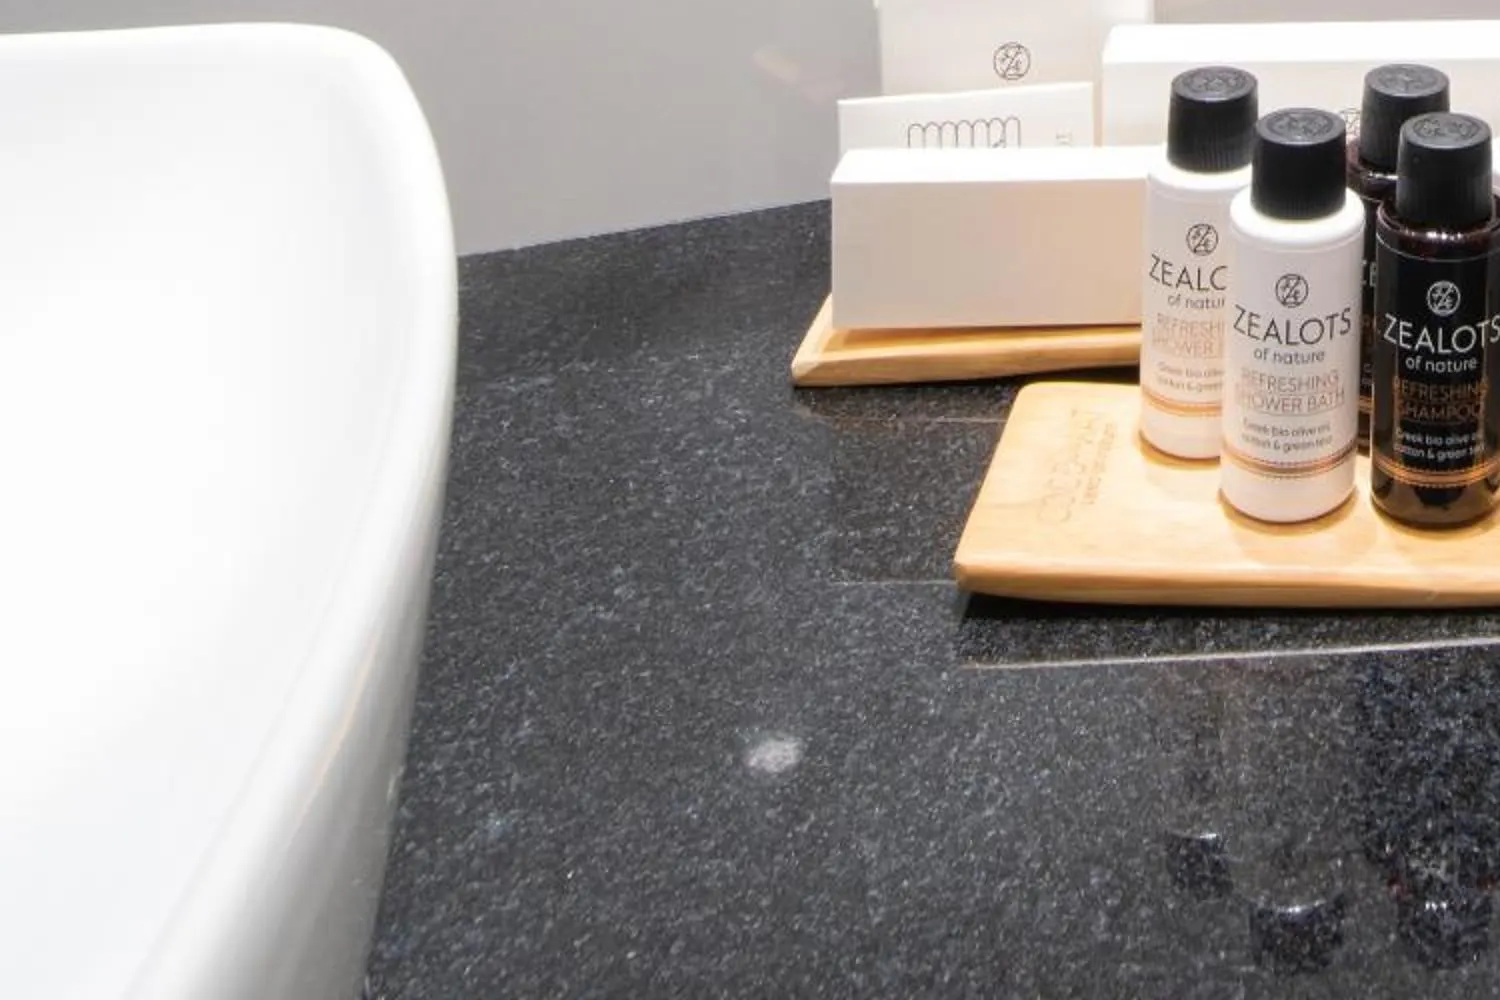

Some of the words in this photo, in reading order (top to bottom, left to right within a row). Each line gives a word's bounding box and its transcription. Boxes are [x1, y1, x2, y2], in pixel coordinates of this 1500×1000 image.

[1149, 253, 1228, 292] ZEALO
[1168, 293, 1182, 306] of
[1233, 304, 1352, 347] ZEALOTS
[1383, 313, 1500, 354] ZEALOTS
[1254, 348, 1269, 361] of
[1274, 349, 1326, 365] nature
[1405, 355, 1422, 371] of
[1424, 358, 1479, 374] nature
[1240, 367, 1340, 394] REFRESHING
